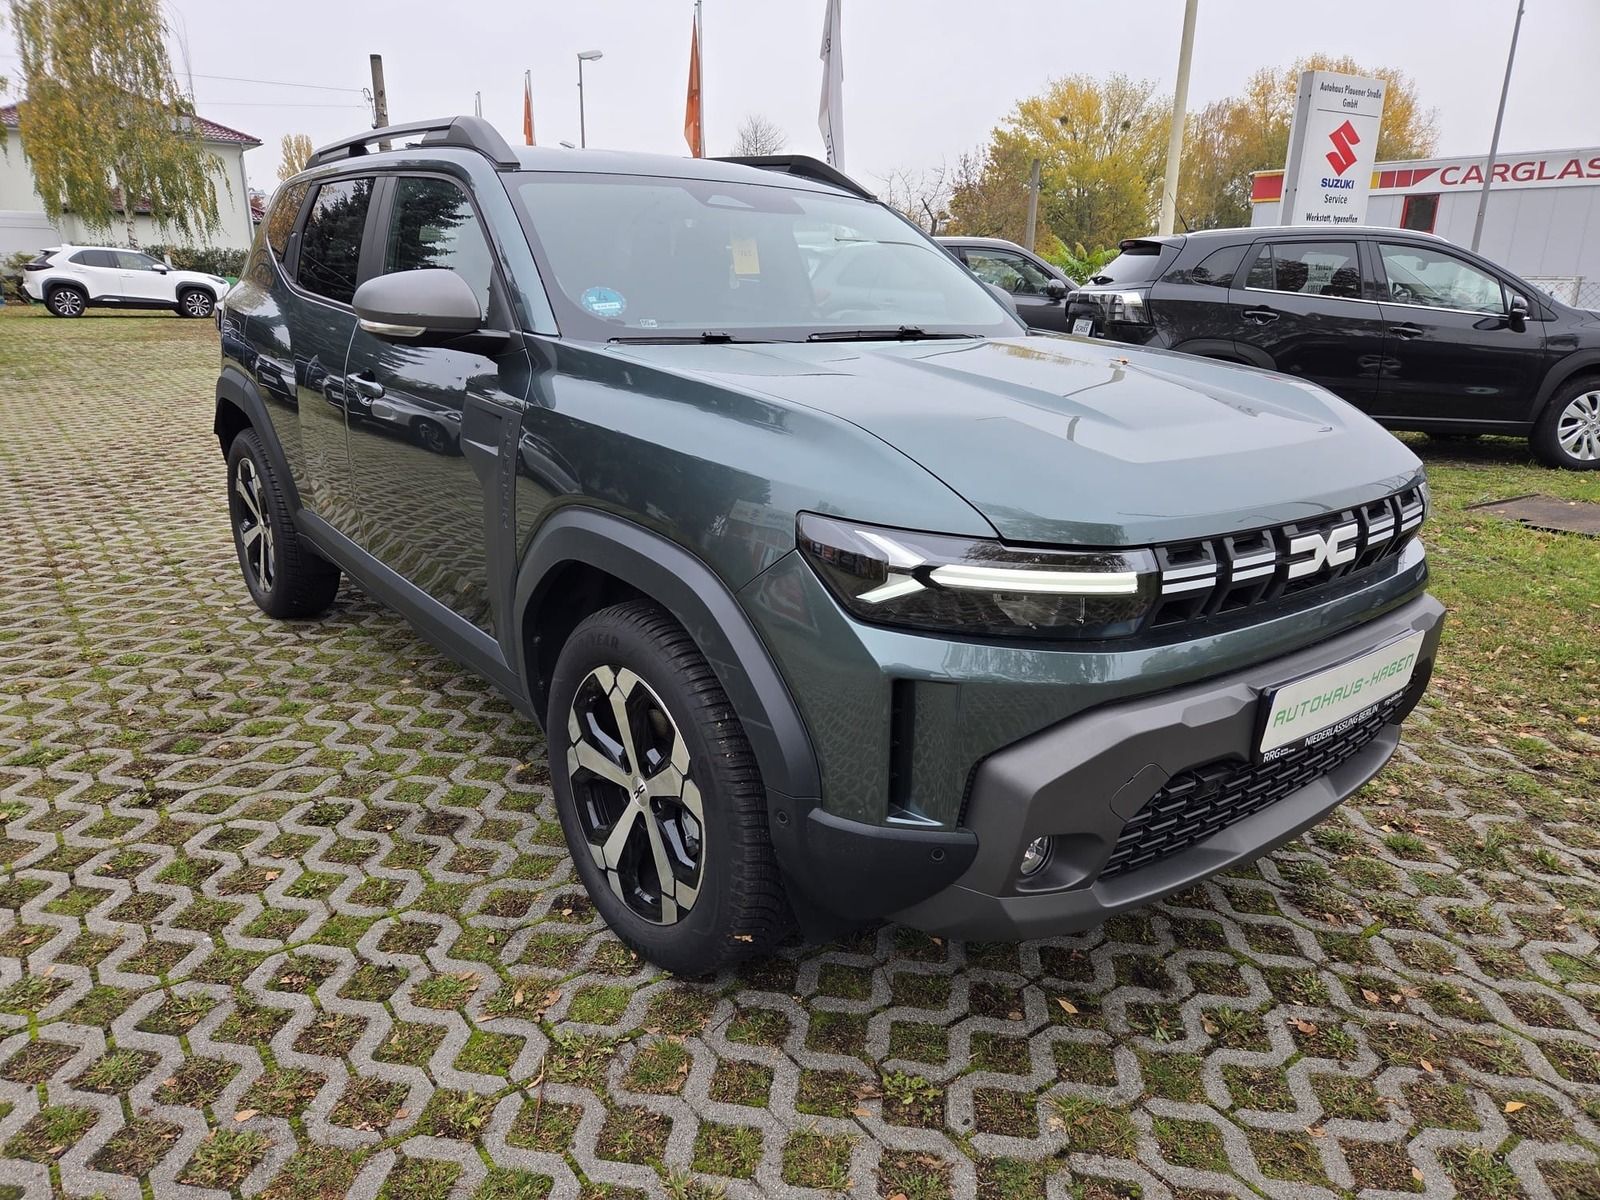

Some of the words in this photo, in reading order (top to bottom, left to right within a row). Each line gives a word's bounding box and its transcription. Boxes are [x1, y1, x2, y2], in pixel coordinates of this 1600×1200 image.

[1320, 82, 1344, 94] Autohaus
[1345, 84, 1366, 97] Plauener
[1367, 88, 1381, 99] Straße
[1342, 98, 1358, 109] GmbH
[1321, 178, 1355, 190] SUZUKI
[1324, 193, 1348, 204] Service
[1273, 653, 1414, 728] AUTOHAUS-HAGEN
[1263, 748, 1281, 763] RRG
[1304, 715, 1359, 747] NIEDERLASSUNG
[1358, 704, 1380, 721] BERLIN
